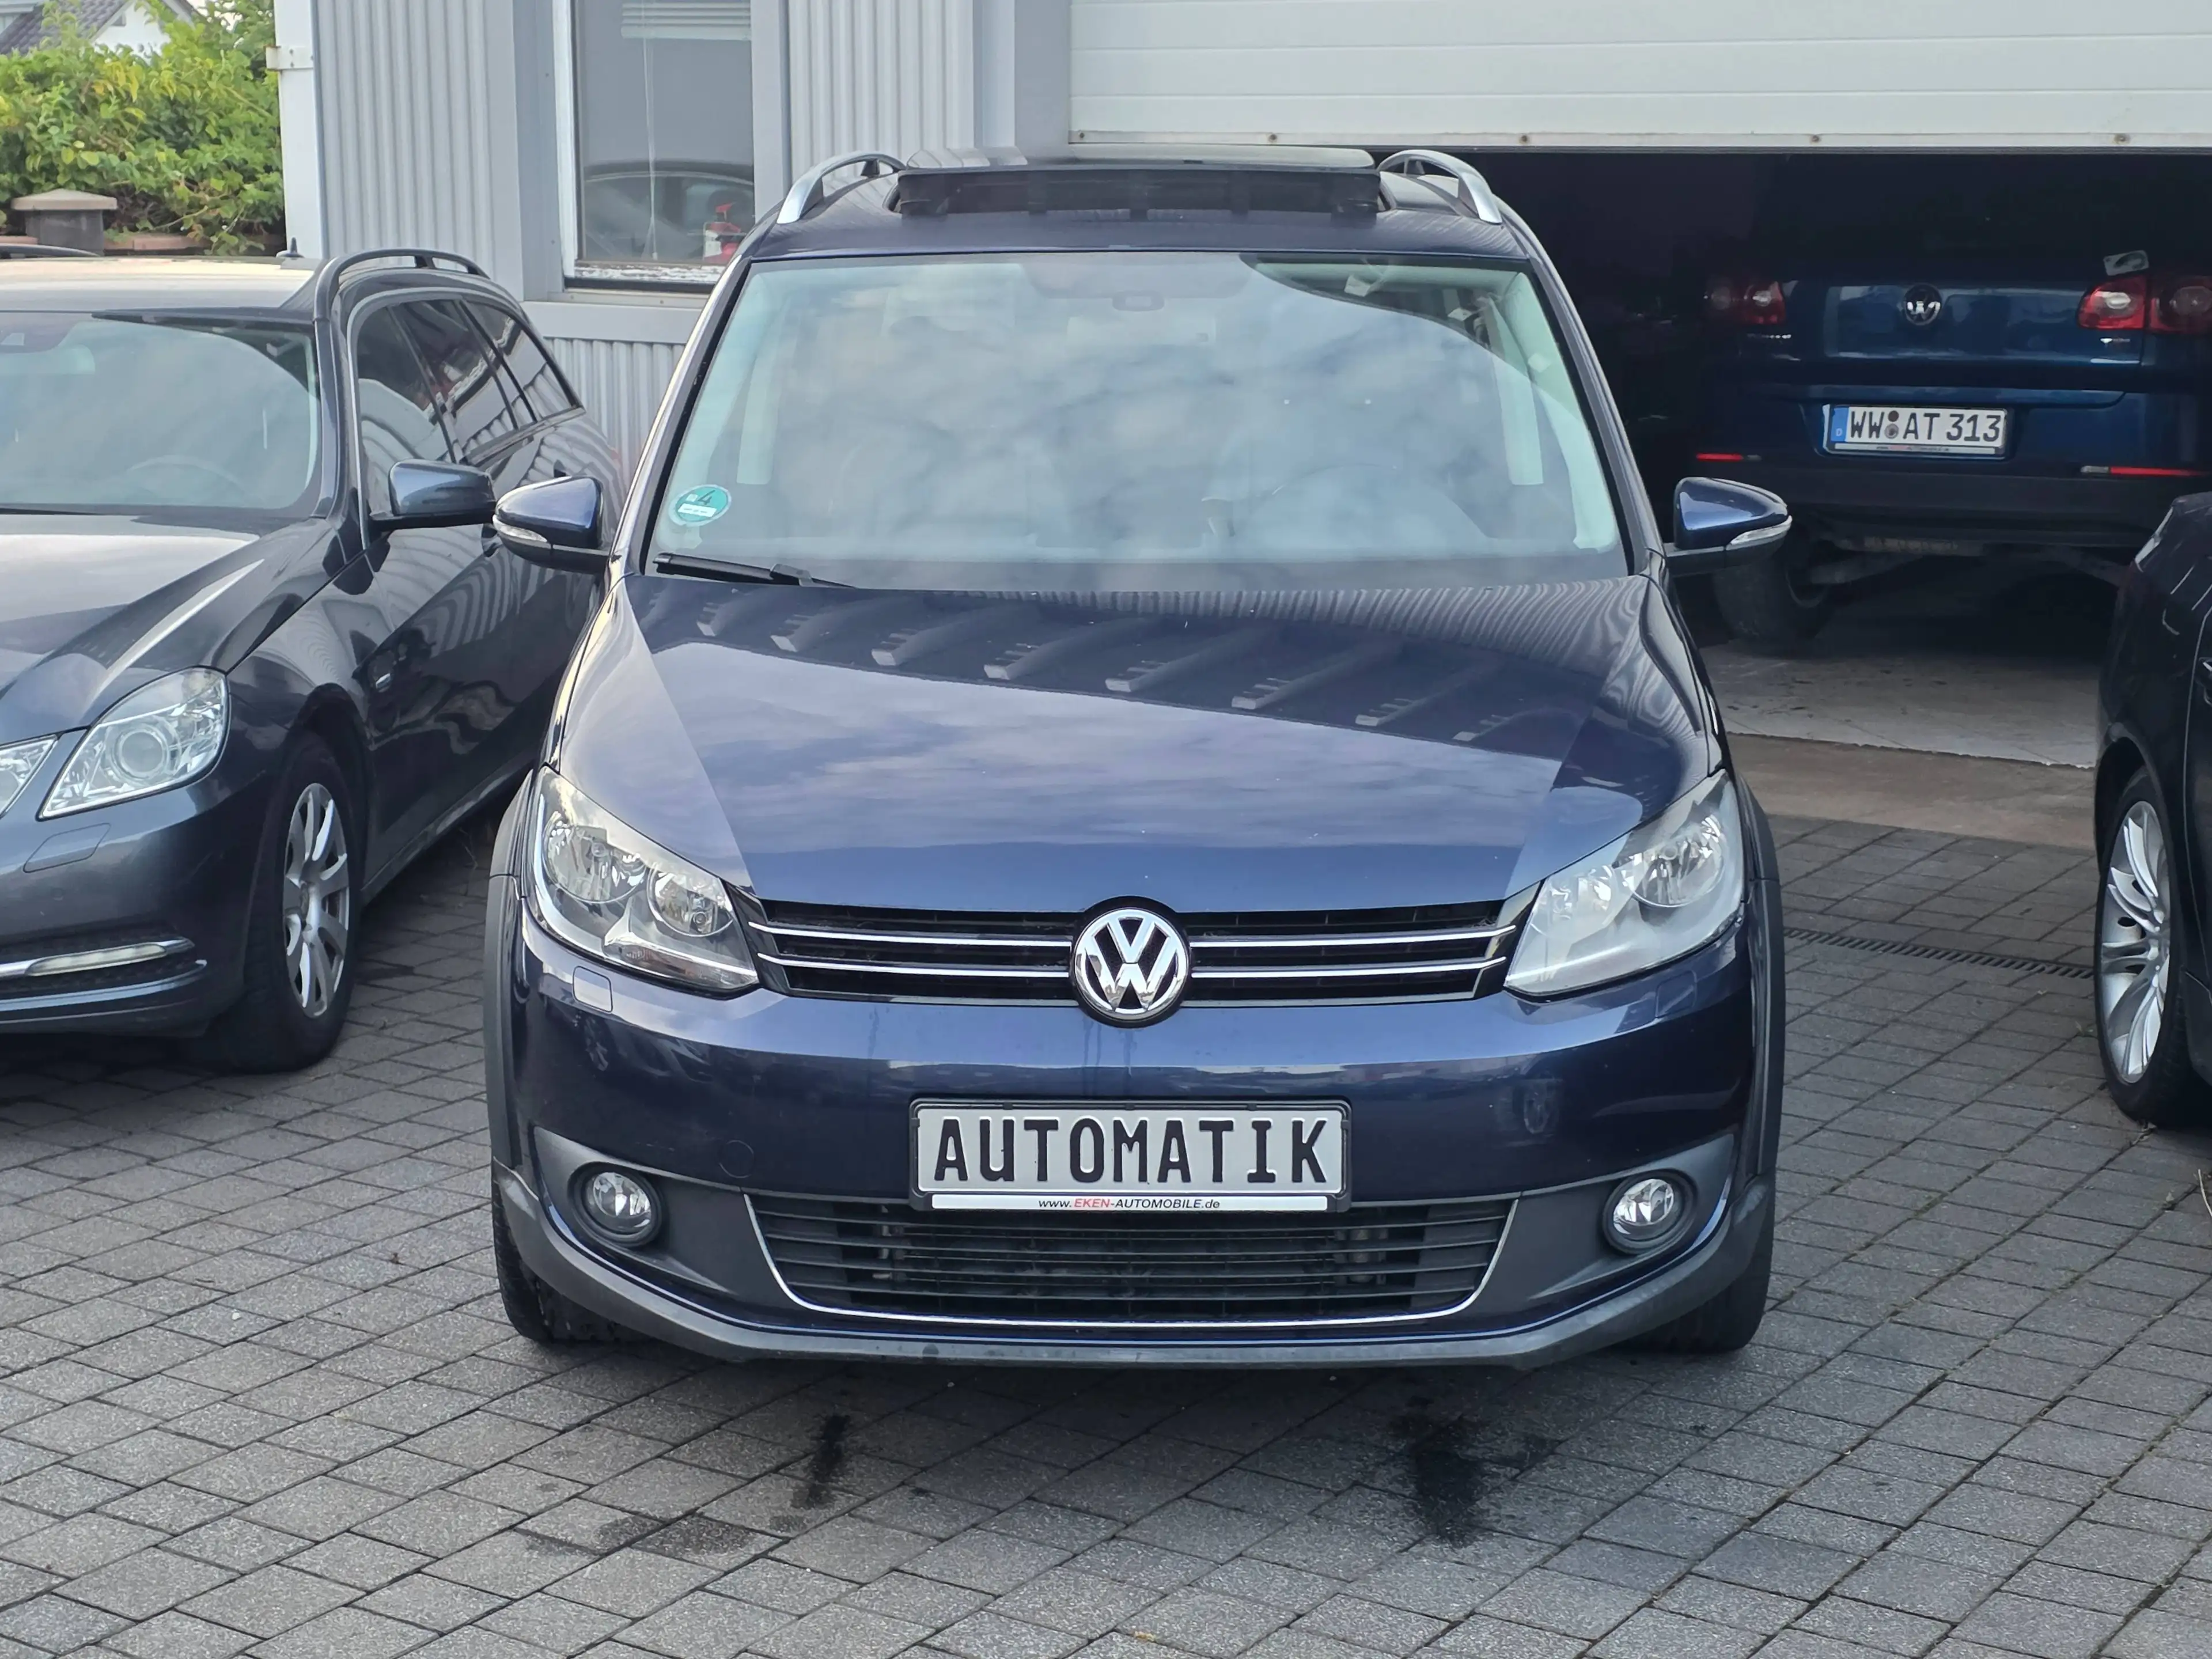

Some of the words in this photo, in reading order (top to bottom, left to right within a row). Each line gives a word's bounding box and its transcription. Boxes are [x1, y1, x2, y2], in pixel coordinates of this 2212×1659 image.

[1835, 428, 1843, 437] D
[1850, 411, 1885, 438] WW
[1903, 412, 1941, 440] AT
[1945, 413, 2002, 442] 313
[697, 490, 716, 505] 4
[1076, 910, 1187, 1018] VW
[934, 1118, 1327, 1183] AUTOMATIK
[1038, 1198, 1221, 1209] www.EKEN-AUTOMOBILE.de
